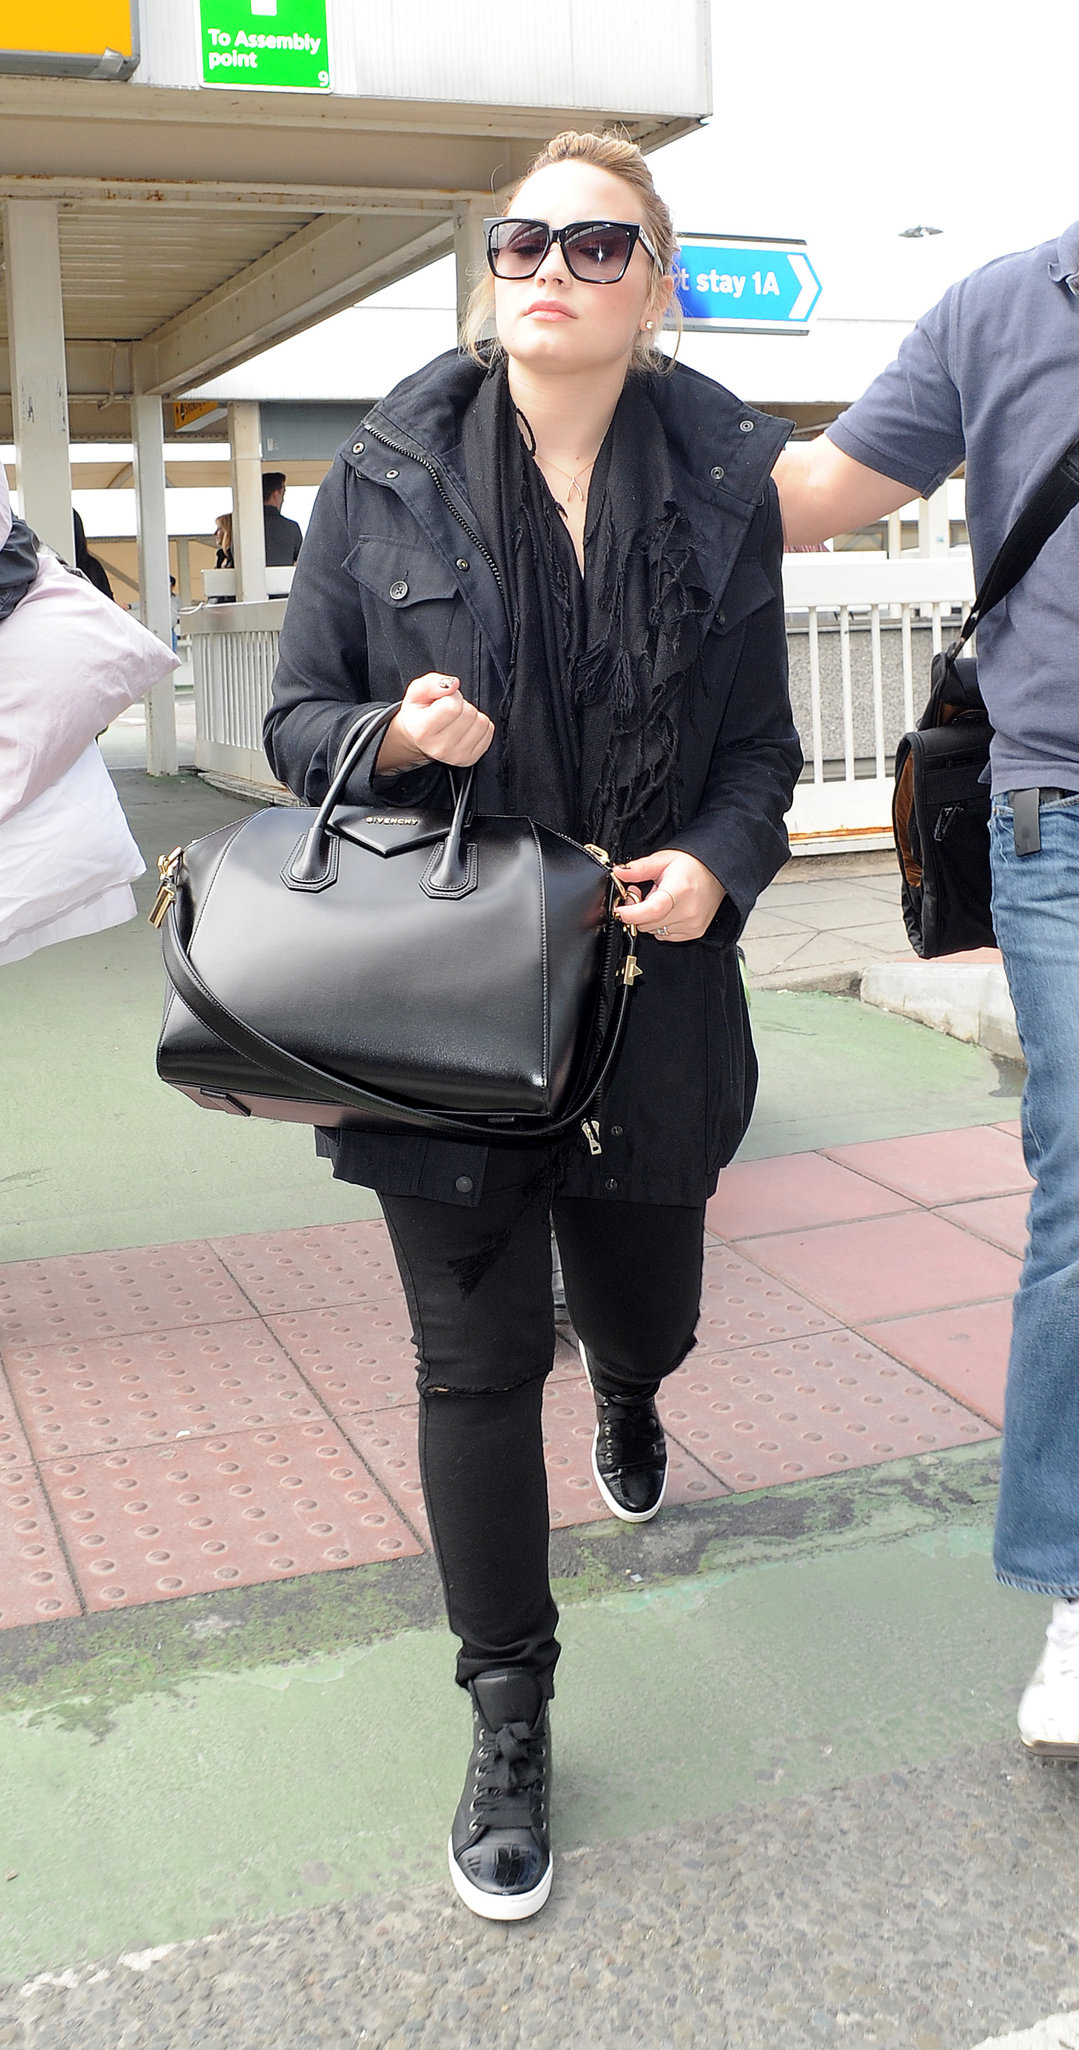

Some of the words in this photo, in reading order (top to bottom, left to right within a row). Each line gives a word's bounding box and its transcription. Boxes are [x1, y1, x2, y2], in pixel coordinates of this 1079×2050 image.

[208, 28, 231, 46] To
[234, 30, 321, 55] Assembly
[208, 50, 258, 70] point
[317, 70, 329, 87] 9
[696, 269, 746, 298] stay
[752, 271, 780, 295] 1A
[366, 816, 418, 826] GIVENCHY
